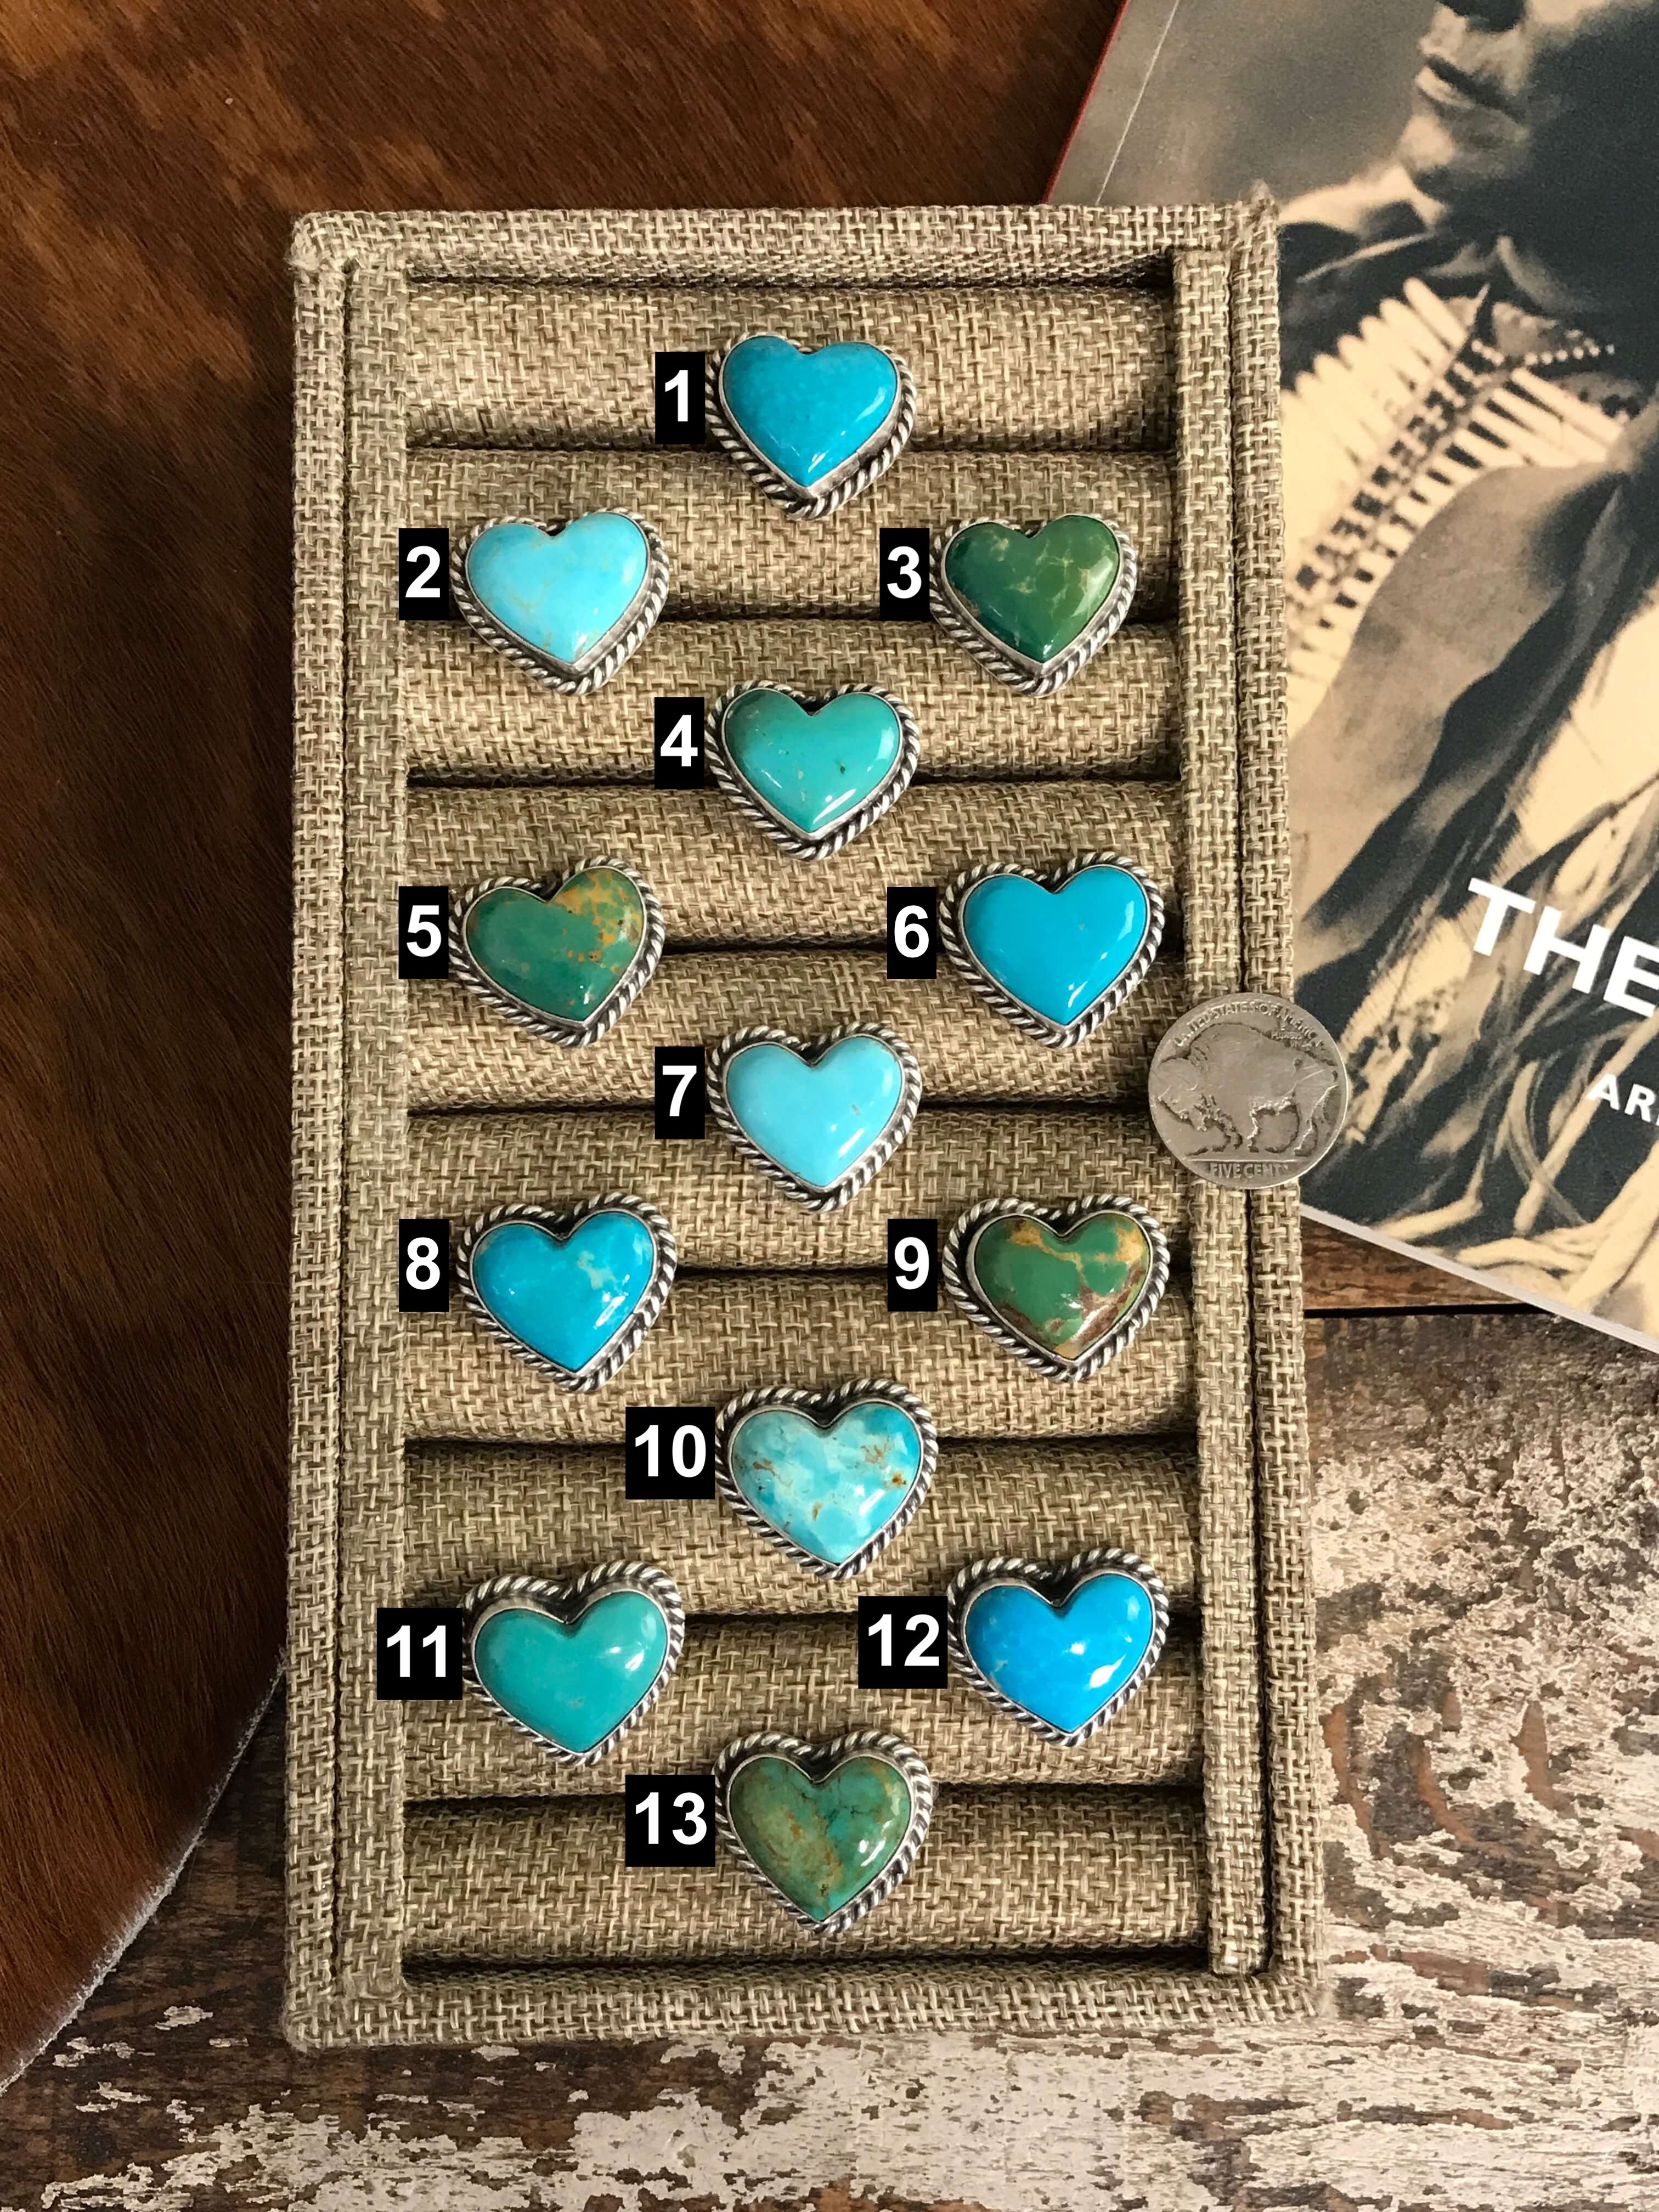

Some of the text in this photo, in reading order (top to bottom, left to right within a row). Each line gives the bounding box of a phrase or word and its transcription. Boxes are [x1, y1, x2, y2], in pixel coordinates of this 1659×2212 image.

[1468, 878, 1659, 1018] THE
[1585, 1073, 1659, 1126] AR
[1210, 1162, 1242, 1178] FIVE
